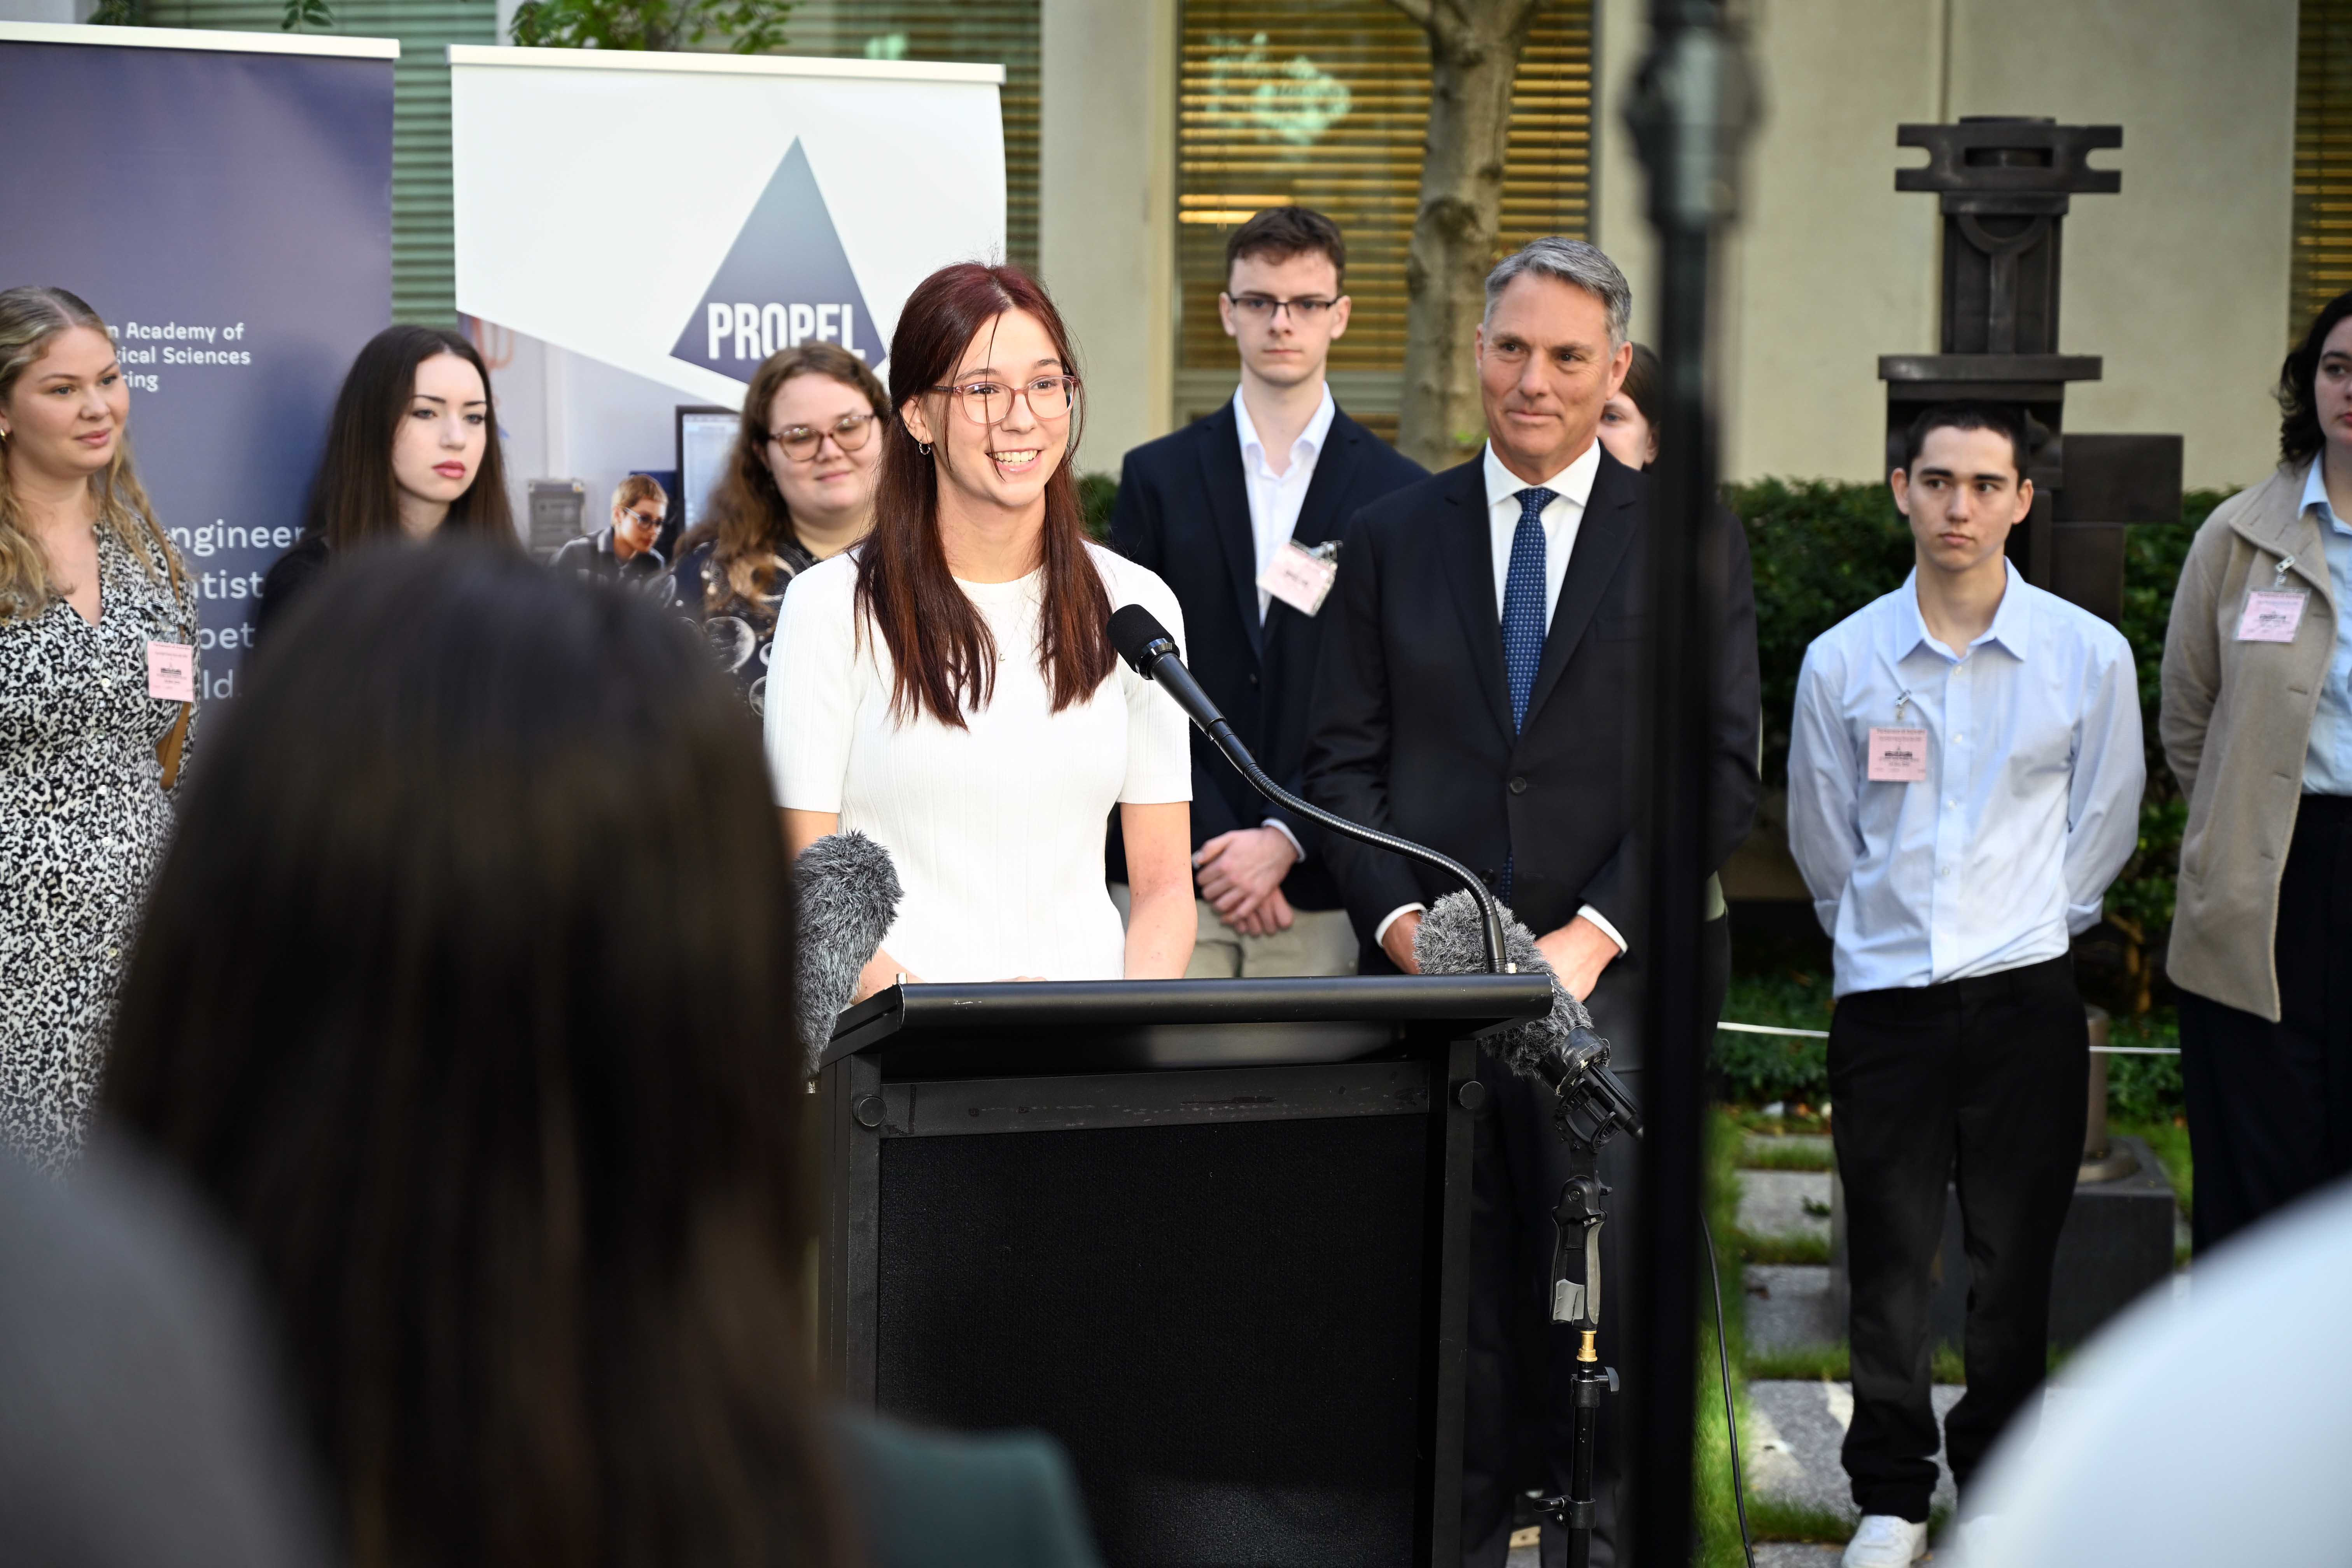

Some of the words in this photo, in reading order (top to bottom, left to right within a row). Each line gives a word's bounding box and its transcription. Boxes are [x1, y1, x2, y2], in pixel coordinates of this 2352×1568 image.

[126, 322, 216, 344] Academy
[223, 322, 244, 340] of
[708, 303, 865, 360] PROPEL
[117, 346, 156, 364] ical
[163, 346, 251, 364] Sciences
